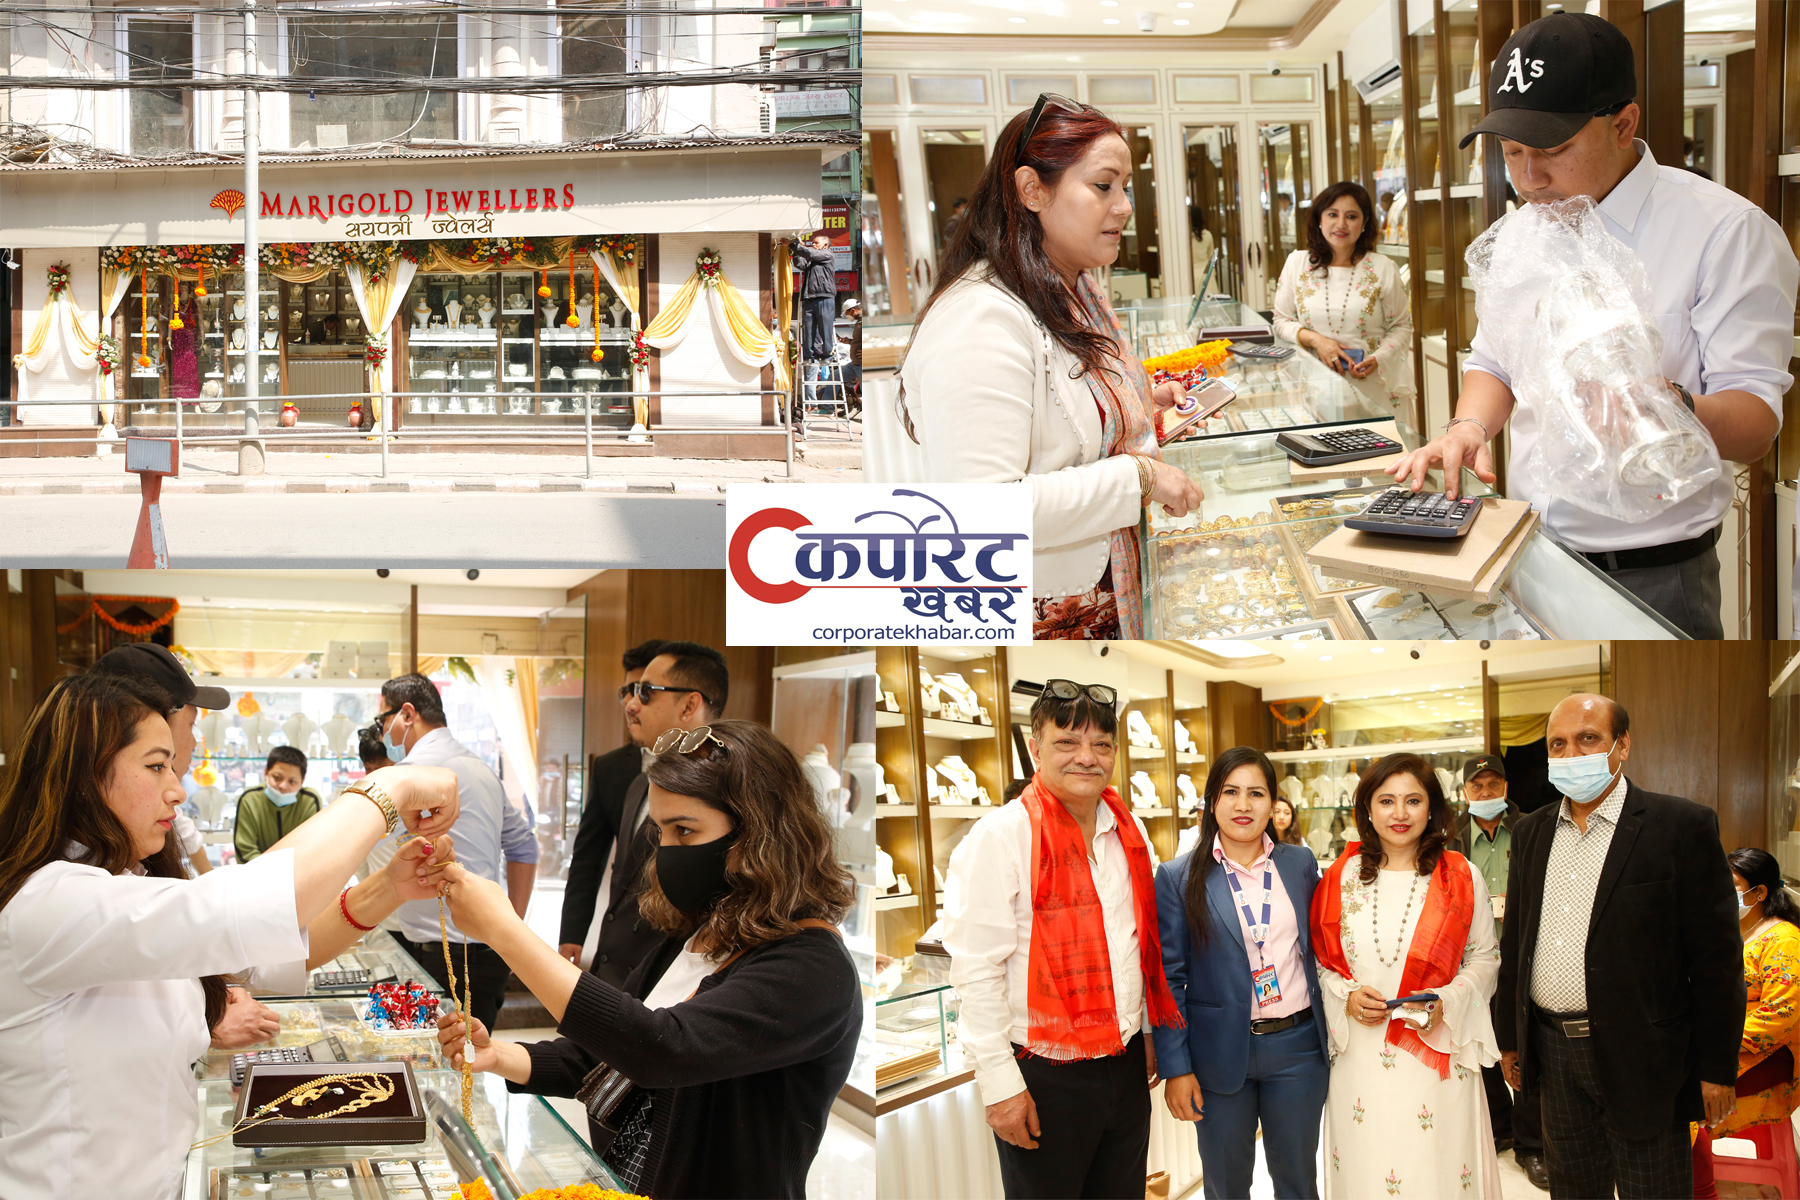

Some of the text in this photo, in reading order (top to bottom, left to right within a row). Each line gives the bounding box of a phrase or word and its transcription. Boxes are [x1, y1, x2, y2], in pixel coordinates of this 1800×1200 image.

[1496, 47, 1545, 94] A's
[259, 183, 575, 220] MARIGOLD JEWELLERS
[345, 212, 495, 237] सयपत्री ज्वेलर्स
[822, 216, 846, 228] TER
[1368, 565, 1410, 579] 501-550
[1262, 996, 1279, 1006] PRESS
